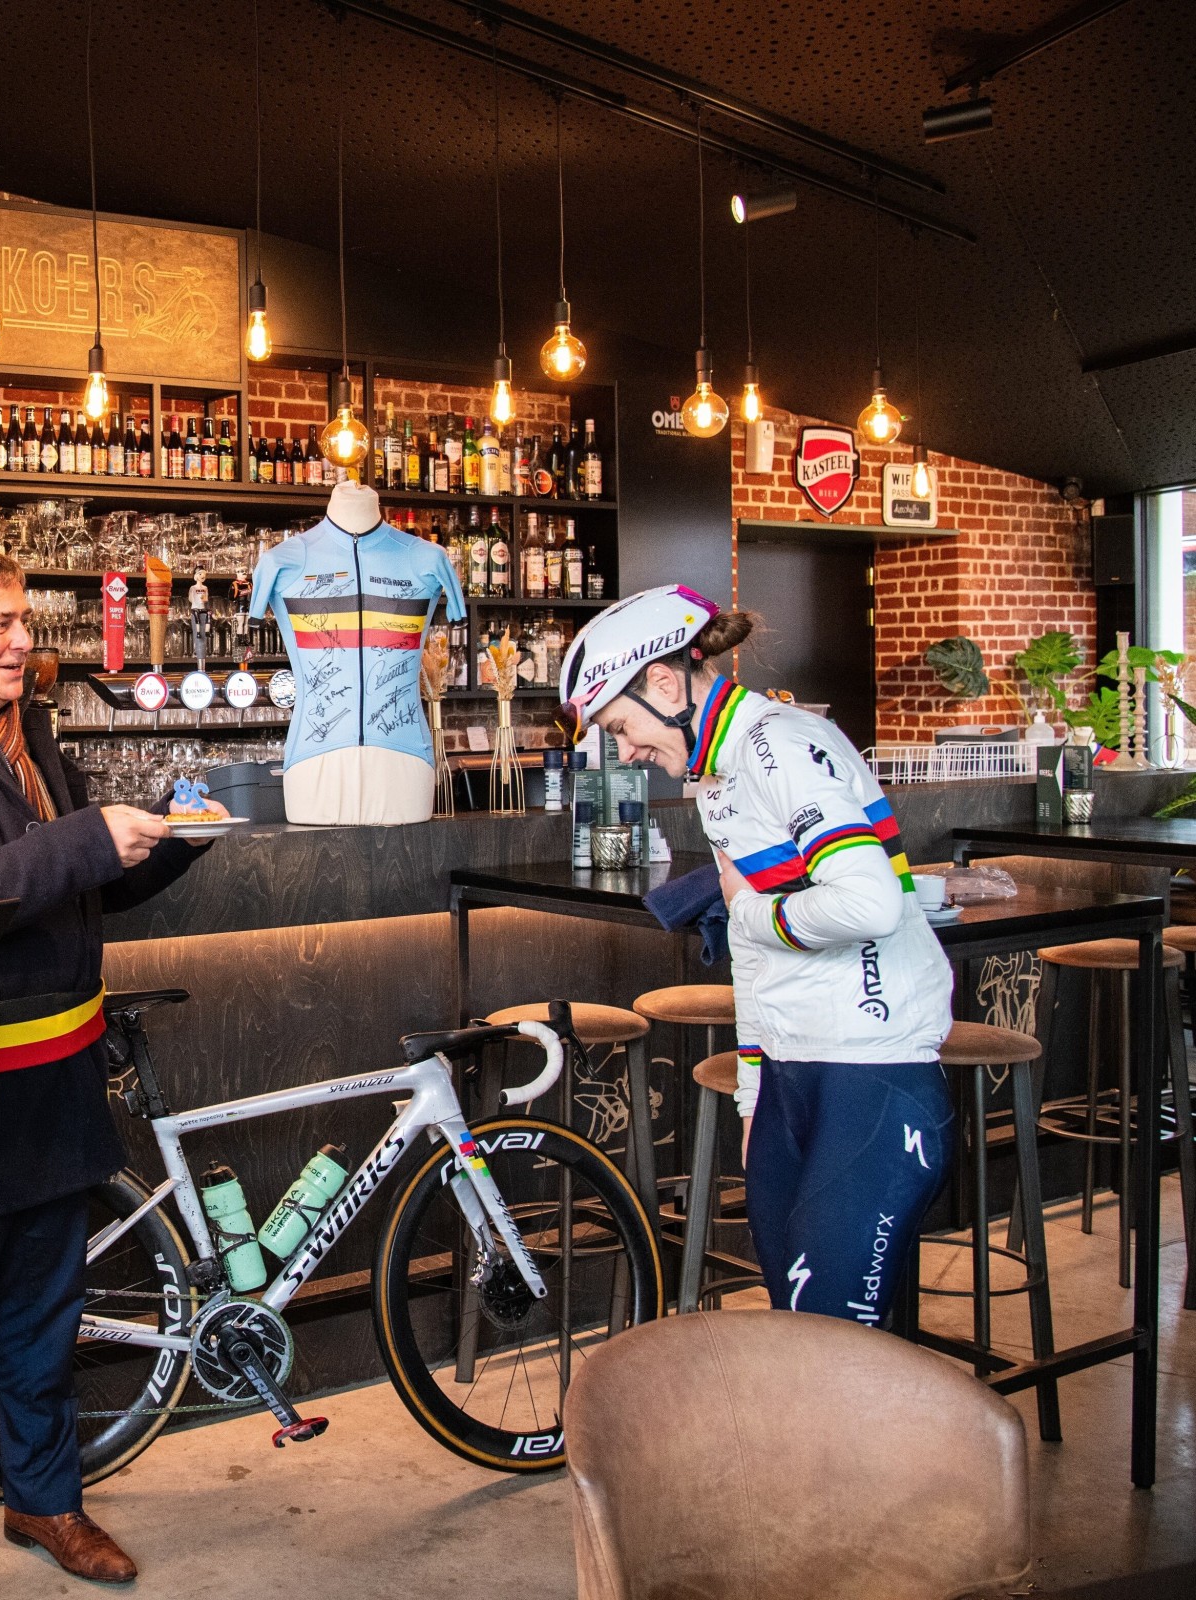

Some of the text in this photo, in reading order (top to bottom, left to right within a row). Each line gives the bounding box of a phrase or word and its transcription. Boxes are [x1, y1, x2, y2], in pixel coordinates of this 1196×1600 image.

[2, 246, 156, 322] KOERS
[802, 454, 851, 482] KASTEEL
[819, 489, 838, 498] BIER
[108, 585, 126, 593] BAVIK
[583, 627, 686, 686] SPECIALIZED
[140, 687, 161, 696] BAVIK
[328, 1075, 395, 1094] SPECIALIZED
[282, 1126, 405, 1295] S-WORKS
[492, 1193, 540, 1275] SPECIALIZED
[79, 1327, 133, 1341] IALIZED
[242, 1365, 292, 1428] SRAM
